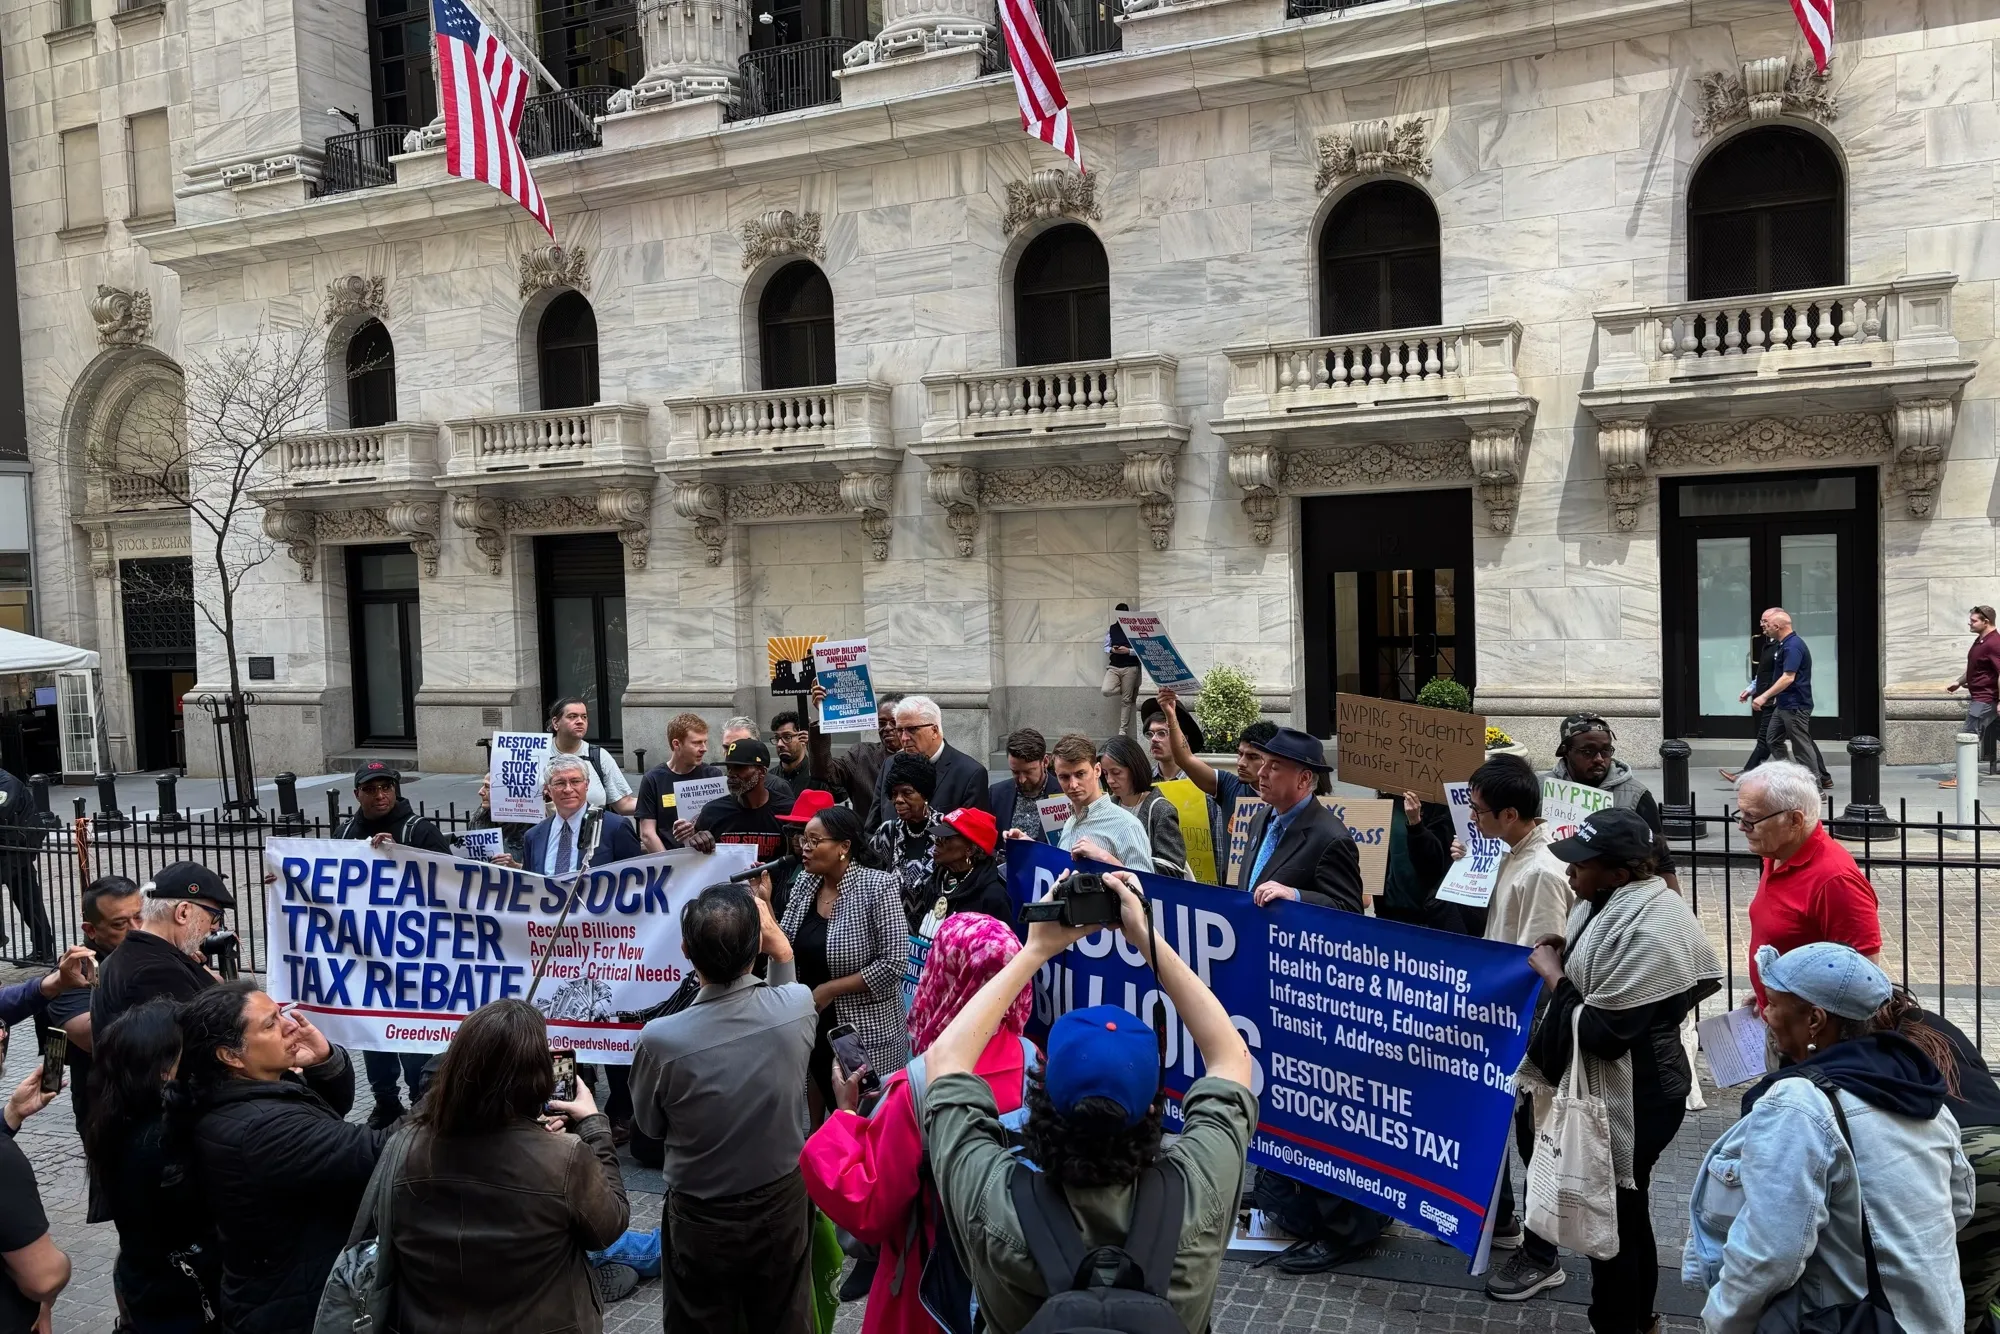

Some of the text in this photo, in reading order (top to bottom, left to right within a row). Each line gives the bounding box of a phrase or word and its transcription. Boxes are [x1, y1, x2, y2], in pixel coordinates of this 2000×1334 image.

[117, 538, 149, 552] STOCK
[815, 647, 842, 657] RECOUP
[826, 653, 858, 664] ANNUALLY
[1340, 702, 1475, 746] NYPIRG Students
[497, 735, 548, 750] RESTORE
[1337, 723, 1445, 763] for the Stock
[510, 748, 533, 762] THE
[501, 760, 538, 775] STOCK
[1339, 746, 1445, 785] transfer TAX
[502, 773, 537, 787] SALES
[506, 785, 532, 799] TAX!
[1544, 781, 1613, 812] NYPIRG
[1040, 803, 1067, 816] RECOUP
[1543, 803, 1578, 821] stands
[463, 832, 500, 847] STORE
[1471, 838, 1501, 857] SALES
[466, 845, 487, 858] THE
[1469, 856, 1494, 873] TAX!
[282, 856, 673, 915] REPEAL THE STOCK
[281, 904, 506, 961] TRANSFER
[581, 921, 637, 940] Billions
[593, 942, 616, 960] For
[617, 942, 645, 961] New
[1268, 923, 1472, 994] For Affordable Housing,
[587, 961, 632, 982] Critical
[634, 964, 682, 983] Needs
[283, 954, 525, 1012] TAX REBATE
[1268, 951, 1522, 1036] Health Care & Mental Health,
[1269, 978, 1490, 1058] Infrastructure, Education,
[1269, 1005, 1328, 1045] Transit,
[1333, 1023, 1404, 1062] Address
[1407, 1043, 1480, 1082] Climate
[1271, 1051, 1414, 1118] RESTORE THE
[1271, 1083, 1461, 1170] STOCK SALES TAX!
[1256, 1138, 1407, 1210] Info@GreedvsNeed.org
[1420, 1200, 1459, 1226] Corporate
